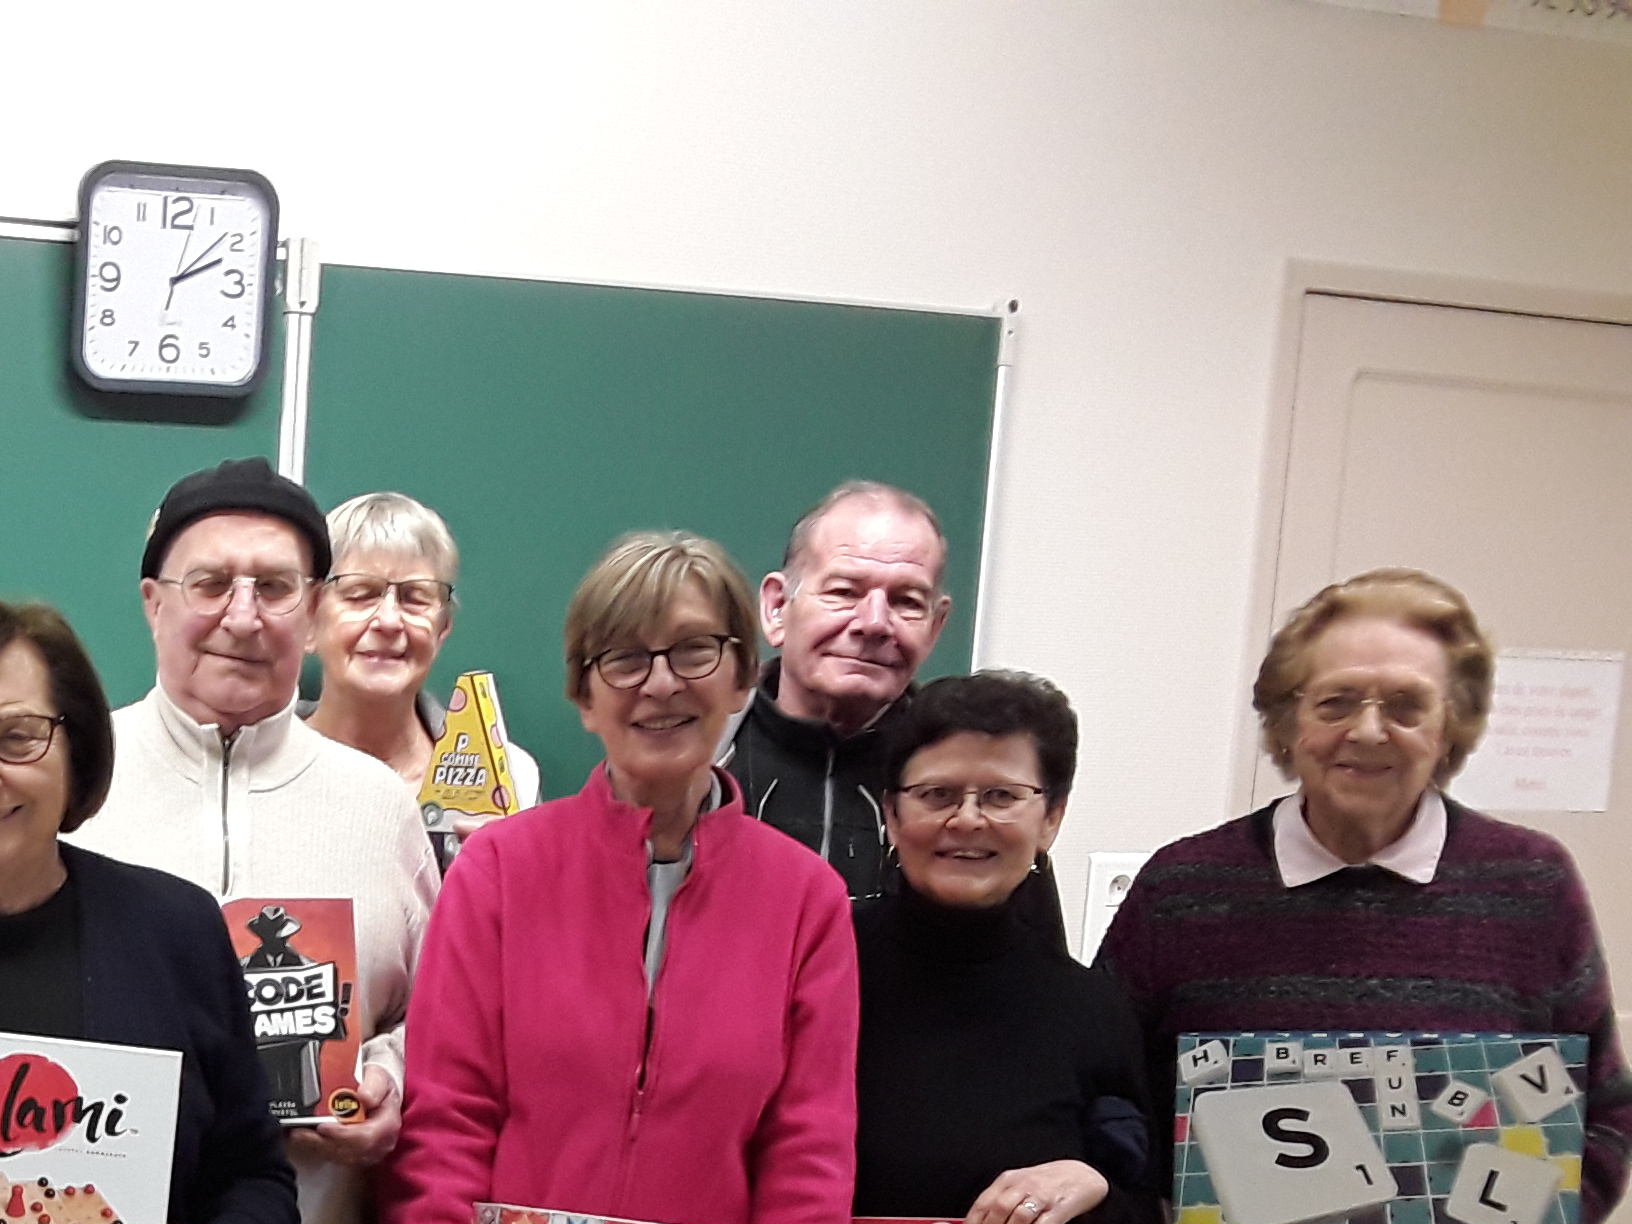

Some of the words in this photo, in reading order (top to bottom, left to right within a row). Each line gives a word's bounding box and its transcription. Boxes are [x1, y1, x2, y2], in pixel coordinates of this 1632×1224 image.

[136, 201, 147, 223] 11
[160, 195, 194, 231] 12
[209, 206, 215, 226] 1
[102, 225, 123, 246] 10
[229, 232, 245, 252] 2
[99, 261, 121, 293] 9
[220, 269, 246, 299] 3
[99, 308, 116, 327] 8
[221, 315, 237, 331] 4
[127, 340, 140, 357] 7
[158, 333, 181, 364] 6
[197, 341, 211, 358] 5
[432, 765, 490, 787] PIZZA
[1191, 1048, 1210, 1068] H
[1519, 1063, 1550, 1095] V
[1261, 1107, 1330, 1169] S
[1355, 1163, 1374, 1186] 1
[1477, 1168, 1509, 1213] L
